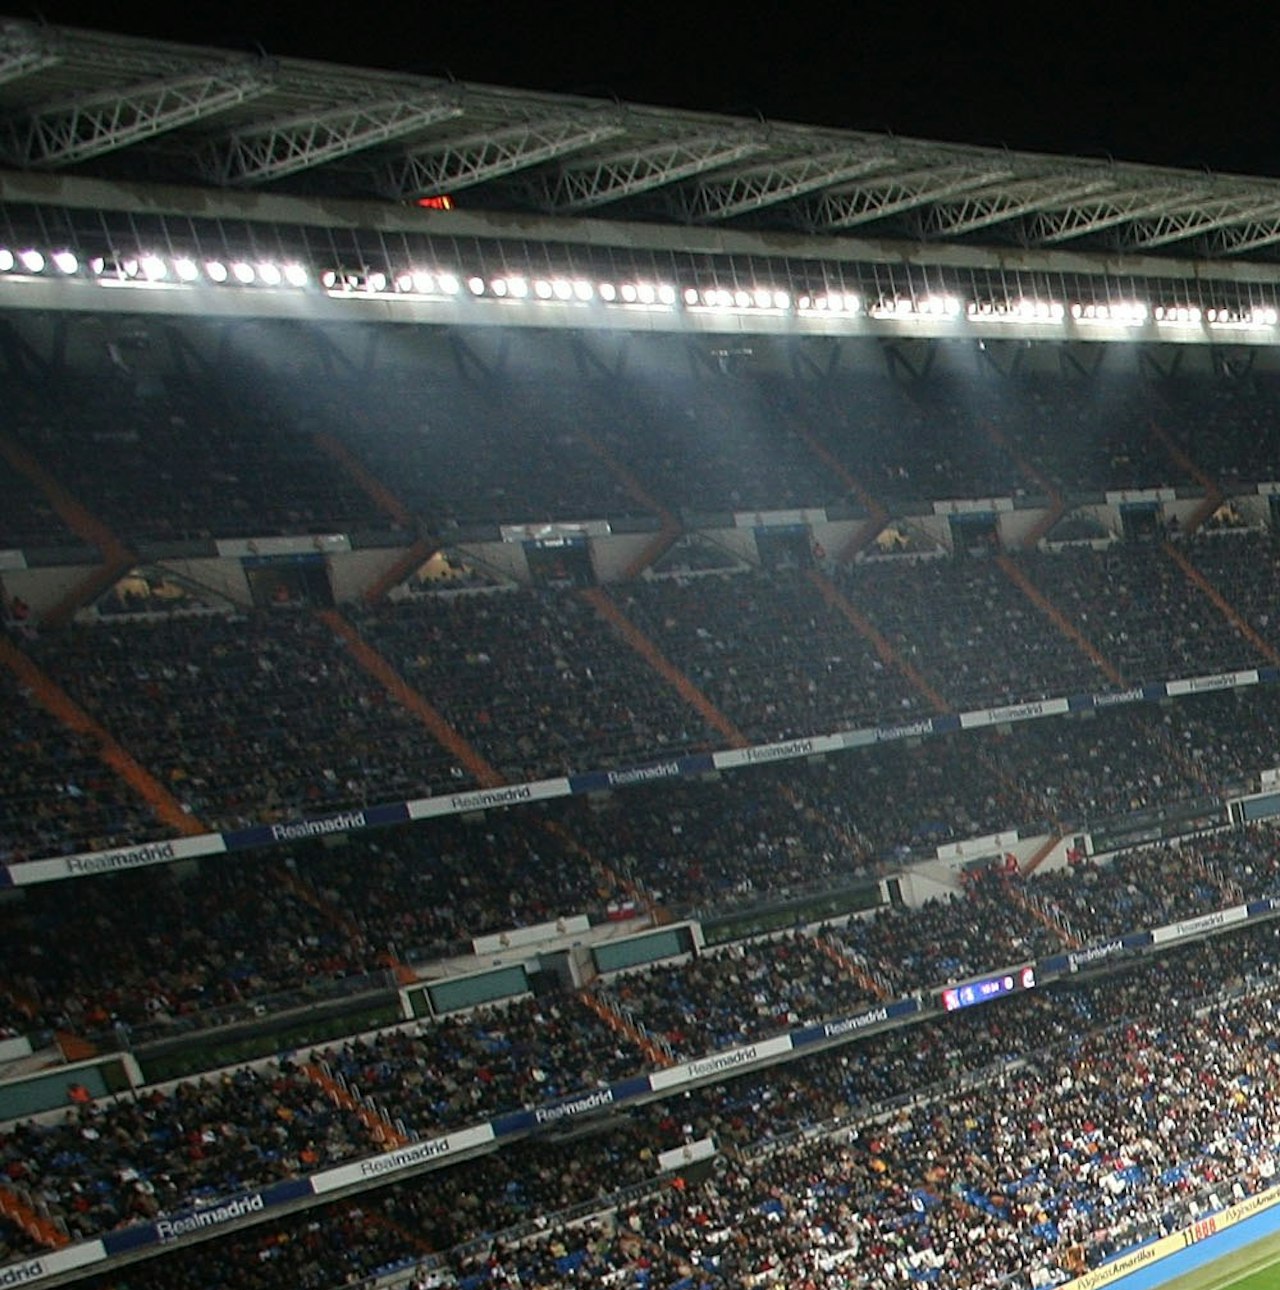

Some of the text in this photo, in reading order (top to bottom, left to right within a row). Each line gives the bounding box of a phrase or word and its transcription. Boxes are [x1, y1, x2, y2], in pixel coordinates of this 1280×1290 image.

[608, 762, 679, 784] Realmadrid
[451, 787, 530, 808] Realmadrid
[272, 812, 366, 841] Realmadrid
[66, 844, 174, 872] Realmadrid
[824, 1008, 887, 1036] Realmadrid
[688, 1048, 756, 1076] Realmadrid
[535, 1090, 613, 1123] Realmadrid
[361, 1140, 450, 1174] Realmadrid
[157, 1195, 263, 1236] Realmadrid
[1182, 1216, 1217, 1247] 11888
